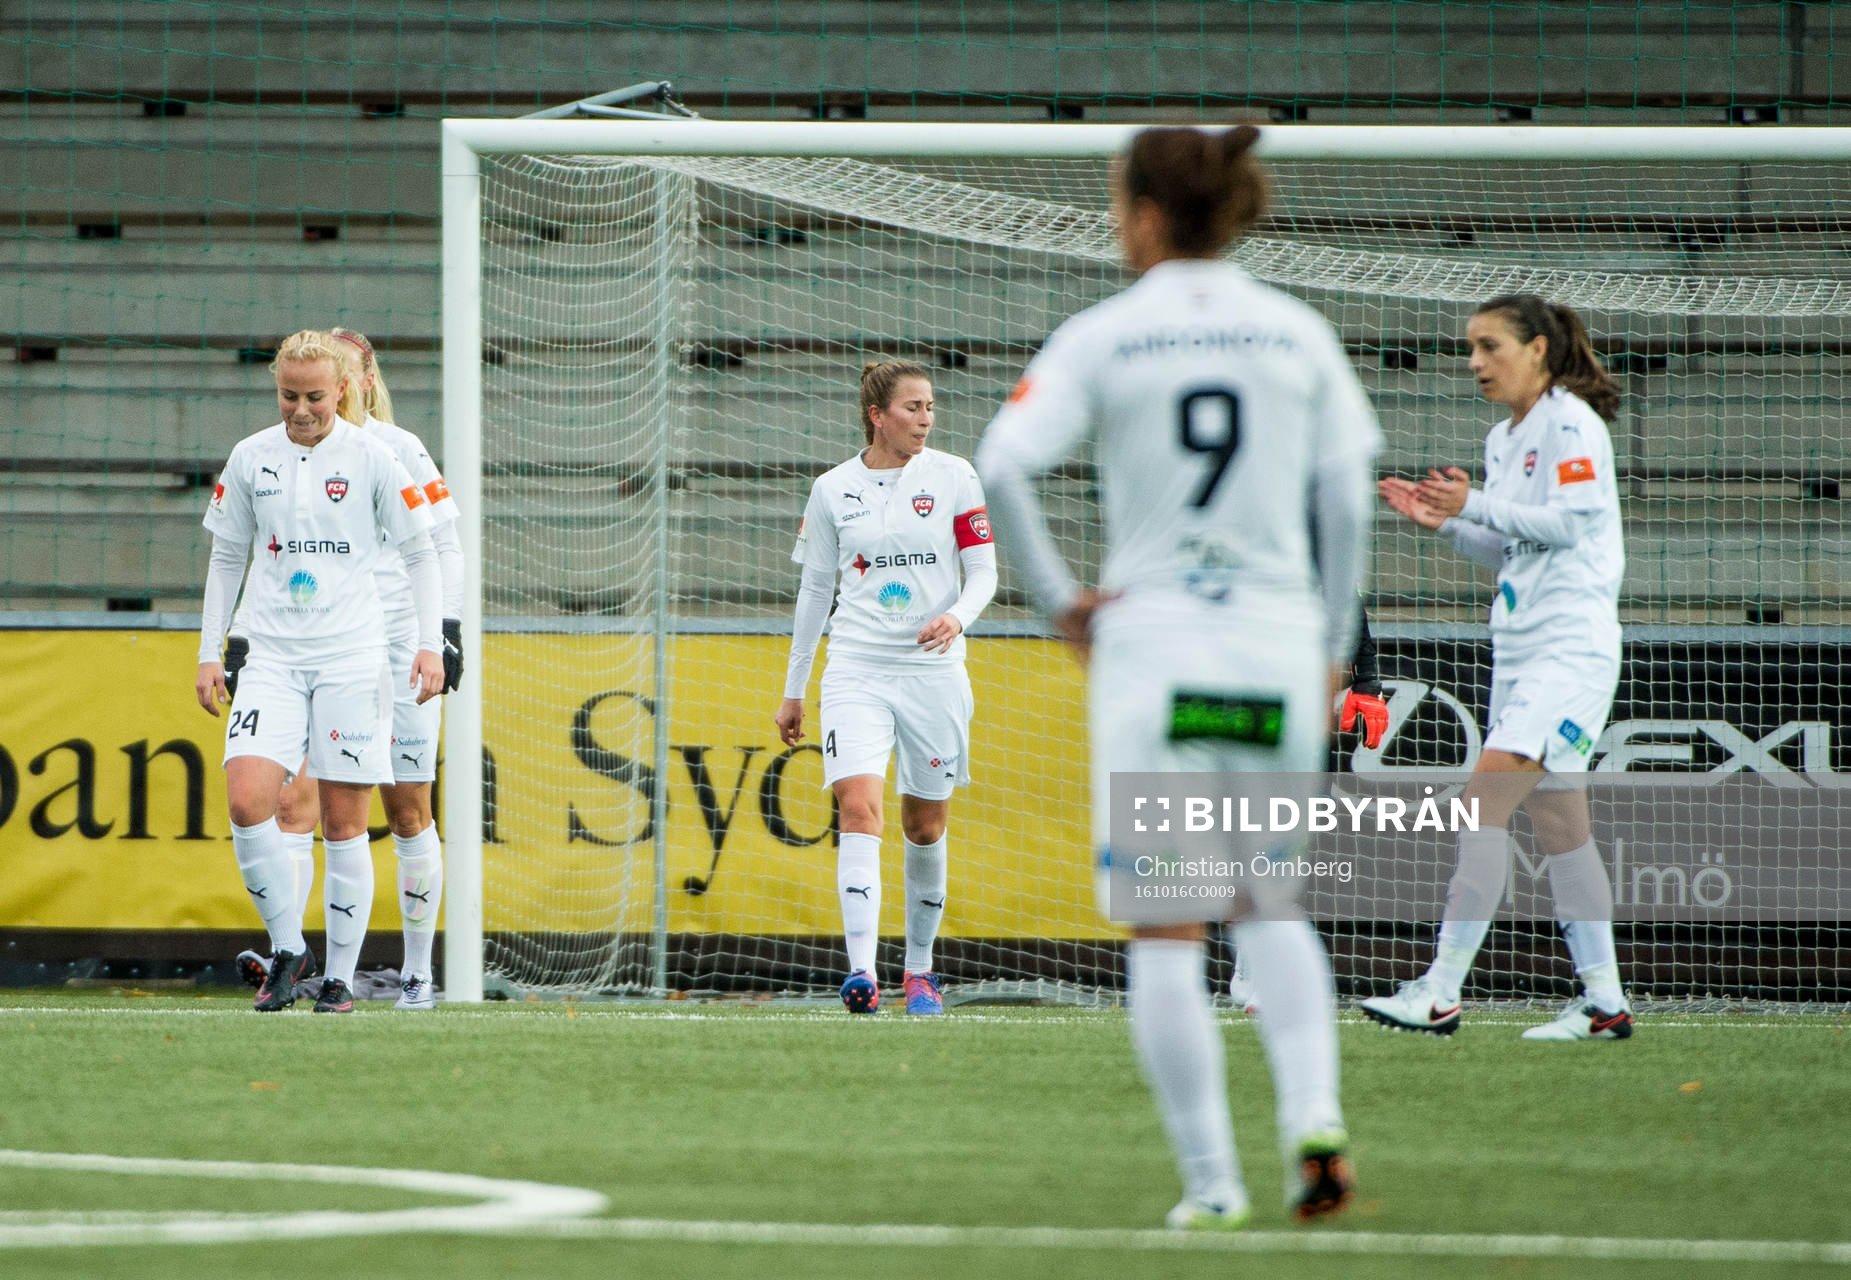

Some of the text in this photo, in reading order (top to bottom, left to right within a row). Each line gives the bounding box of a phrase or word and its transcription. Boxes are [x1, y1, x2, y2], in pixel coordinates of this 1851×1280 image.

[1180, 389, 1241, 507] 9
[327, 482, 346, 492] FCR
[914, 499, 933, 507] FCR
[228, 708, 260, 740] 24
[825, 728, 838, 758] 4
[1505, 837, 1732, 908] Mlmö
